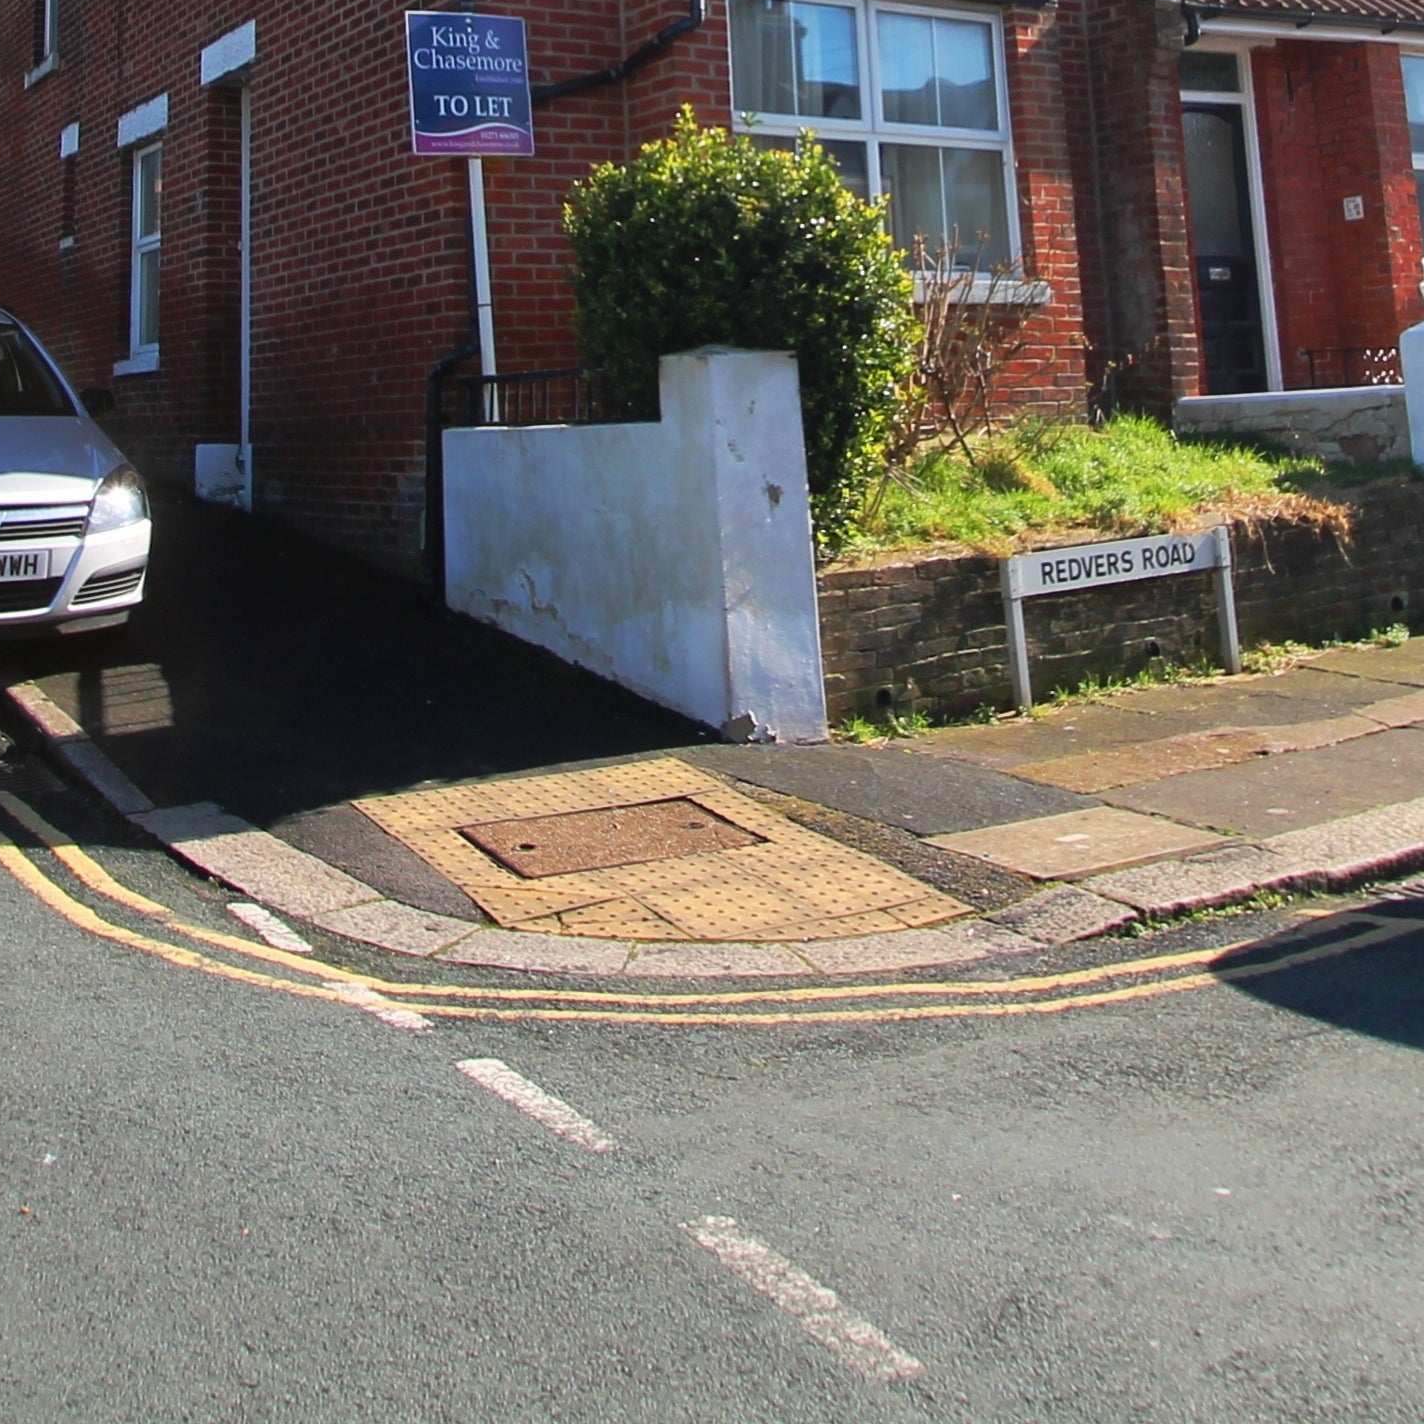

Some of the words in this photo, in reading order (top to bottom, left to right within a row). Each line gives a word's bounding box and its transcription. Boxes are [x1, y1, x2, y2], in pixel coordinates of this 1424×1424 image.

[431, 26, 479, 54] King
[485, 29, 500, 50] &
[414, 48, 523, 73] Chasemore
[433, 95, 468, 117] TO
[474, 95, 513, 118] LET
[1041, 550, 1134, 586] REDVERS
[1142, 542, 1196, 571] ROAD
